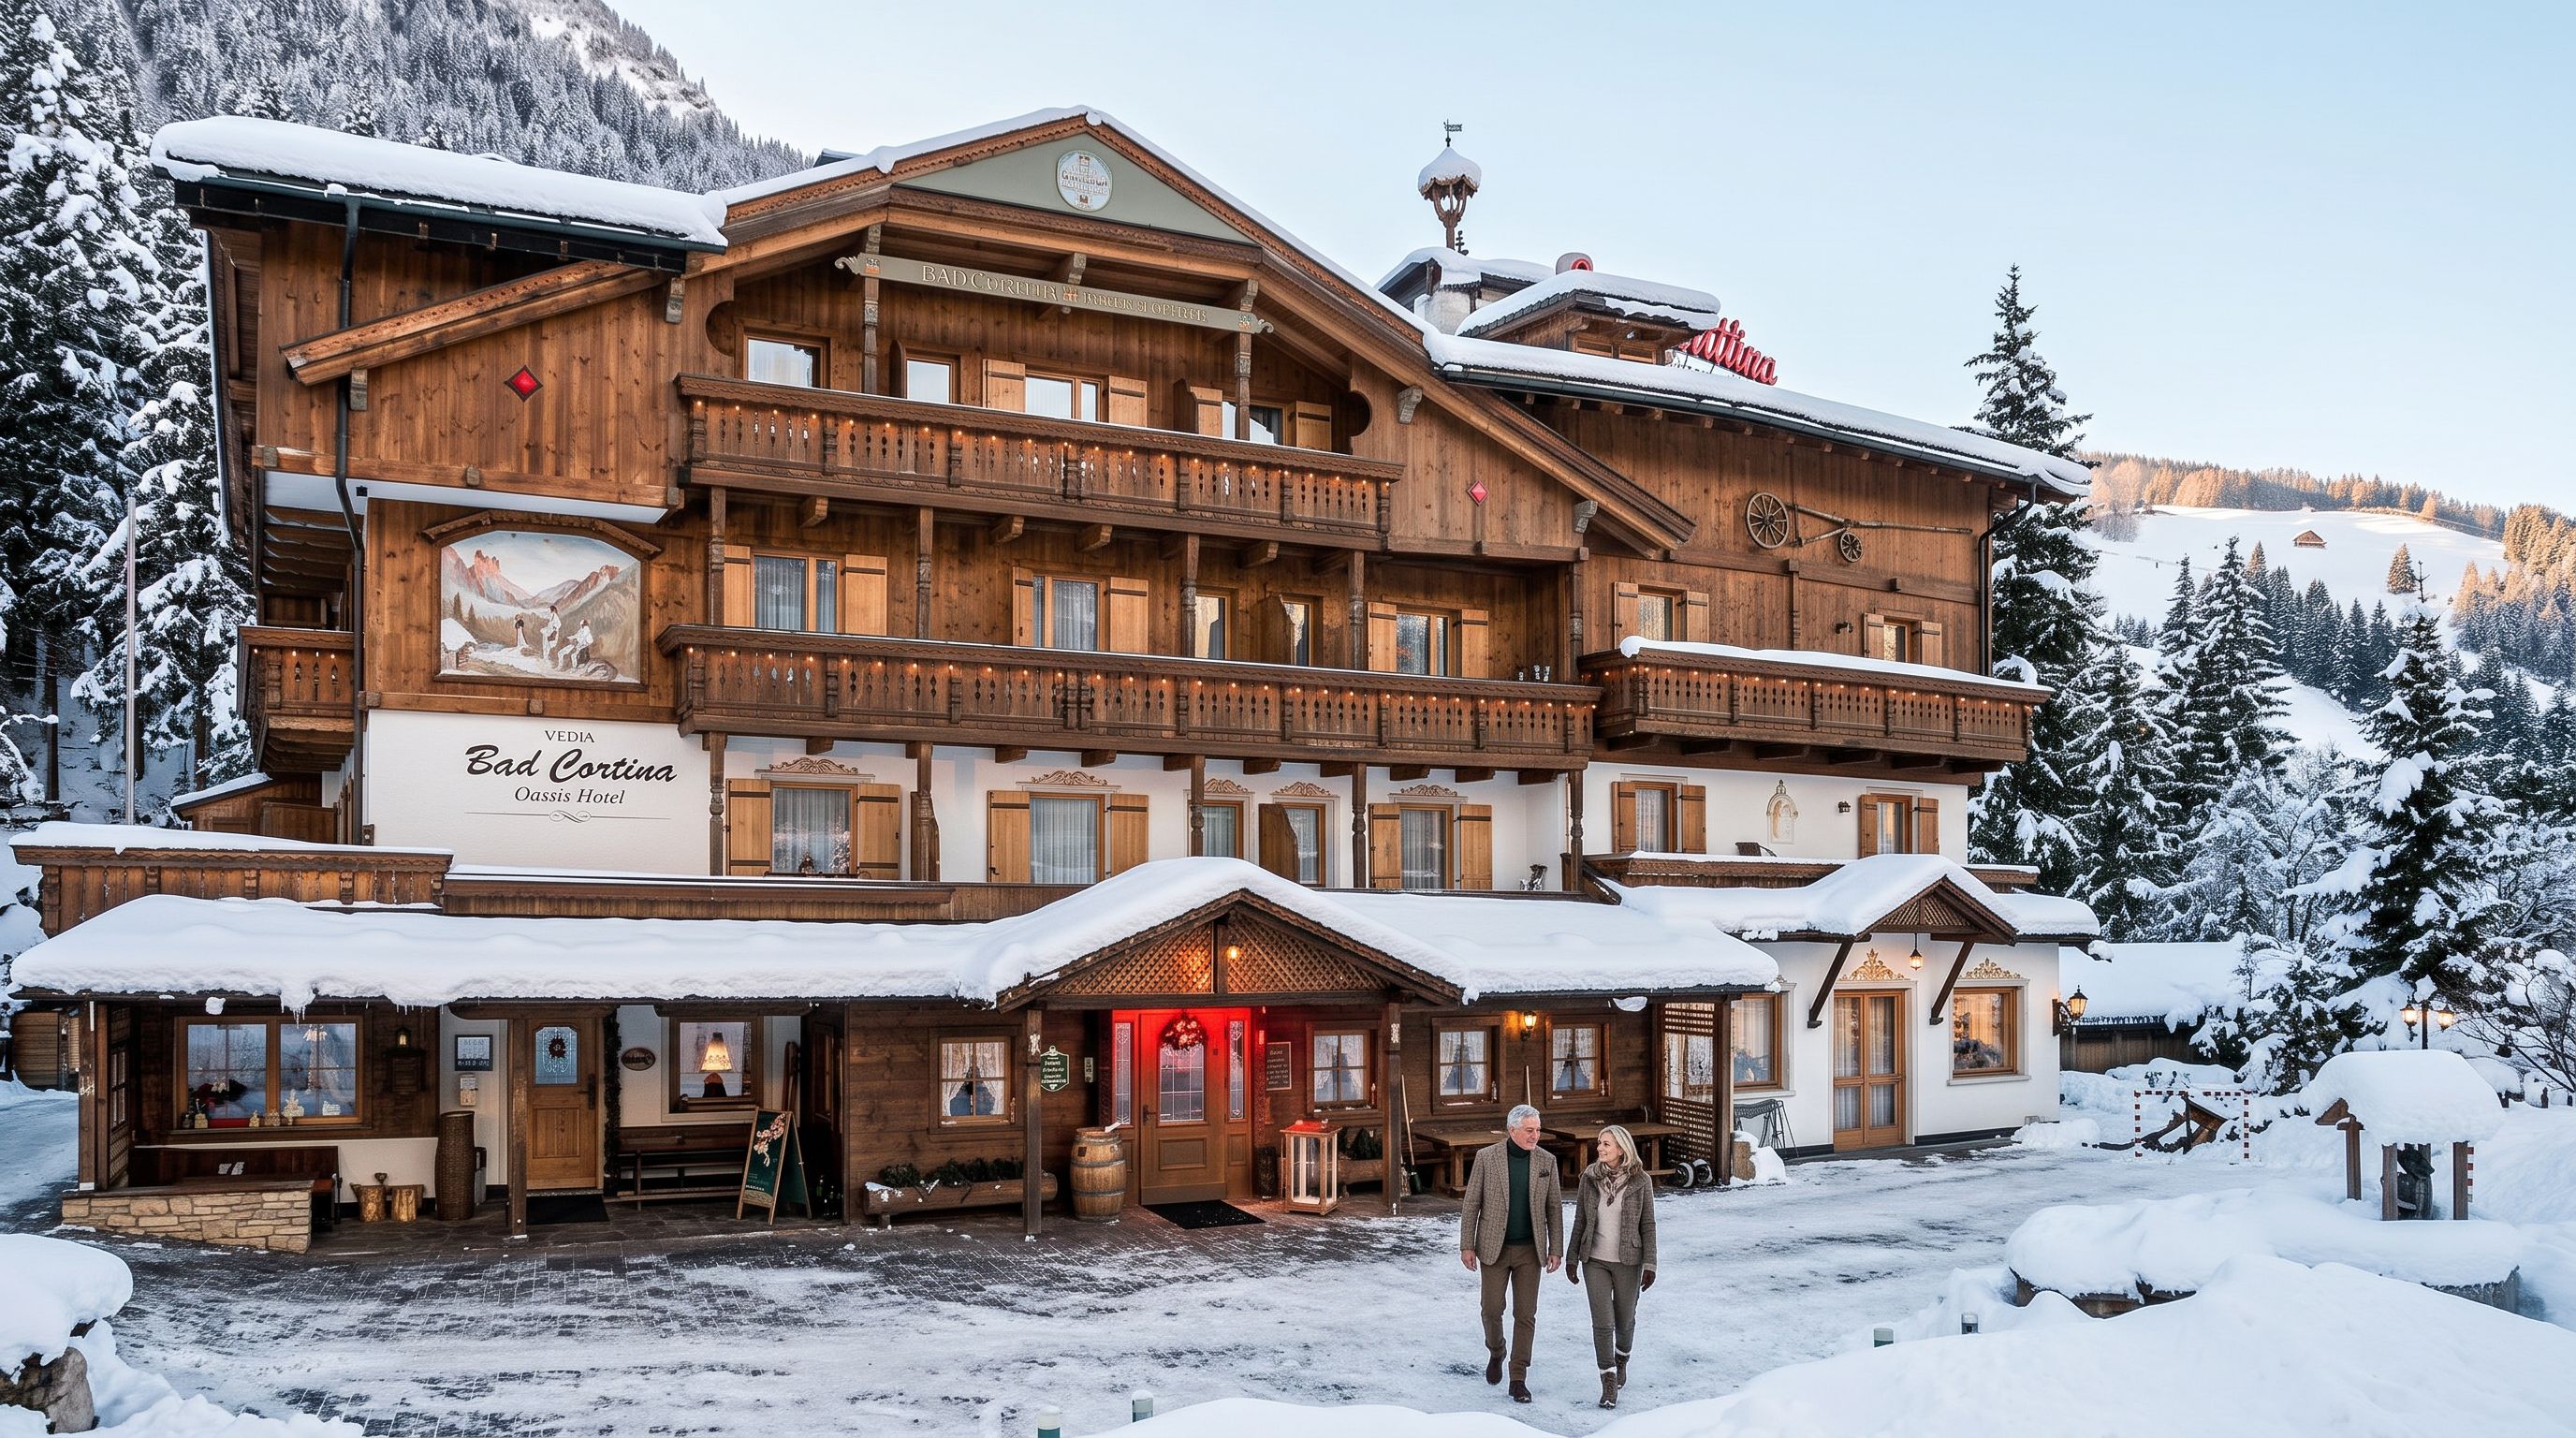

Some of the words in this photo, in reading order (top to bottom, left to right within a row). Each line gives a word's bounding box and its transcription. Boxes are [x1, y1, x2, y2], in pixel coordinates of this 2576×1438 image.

[922, 265, 967, 286] BAD
[545, 730, 595, 743] VEDIA
[464, 743, 543, 777] Bad
[549, 747, 678, 784] Cortina
[514, 785, 571, 802] Oassis
[577, 788, 625, 804] Hotel
